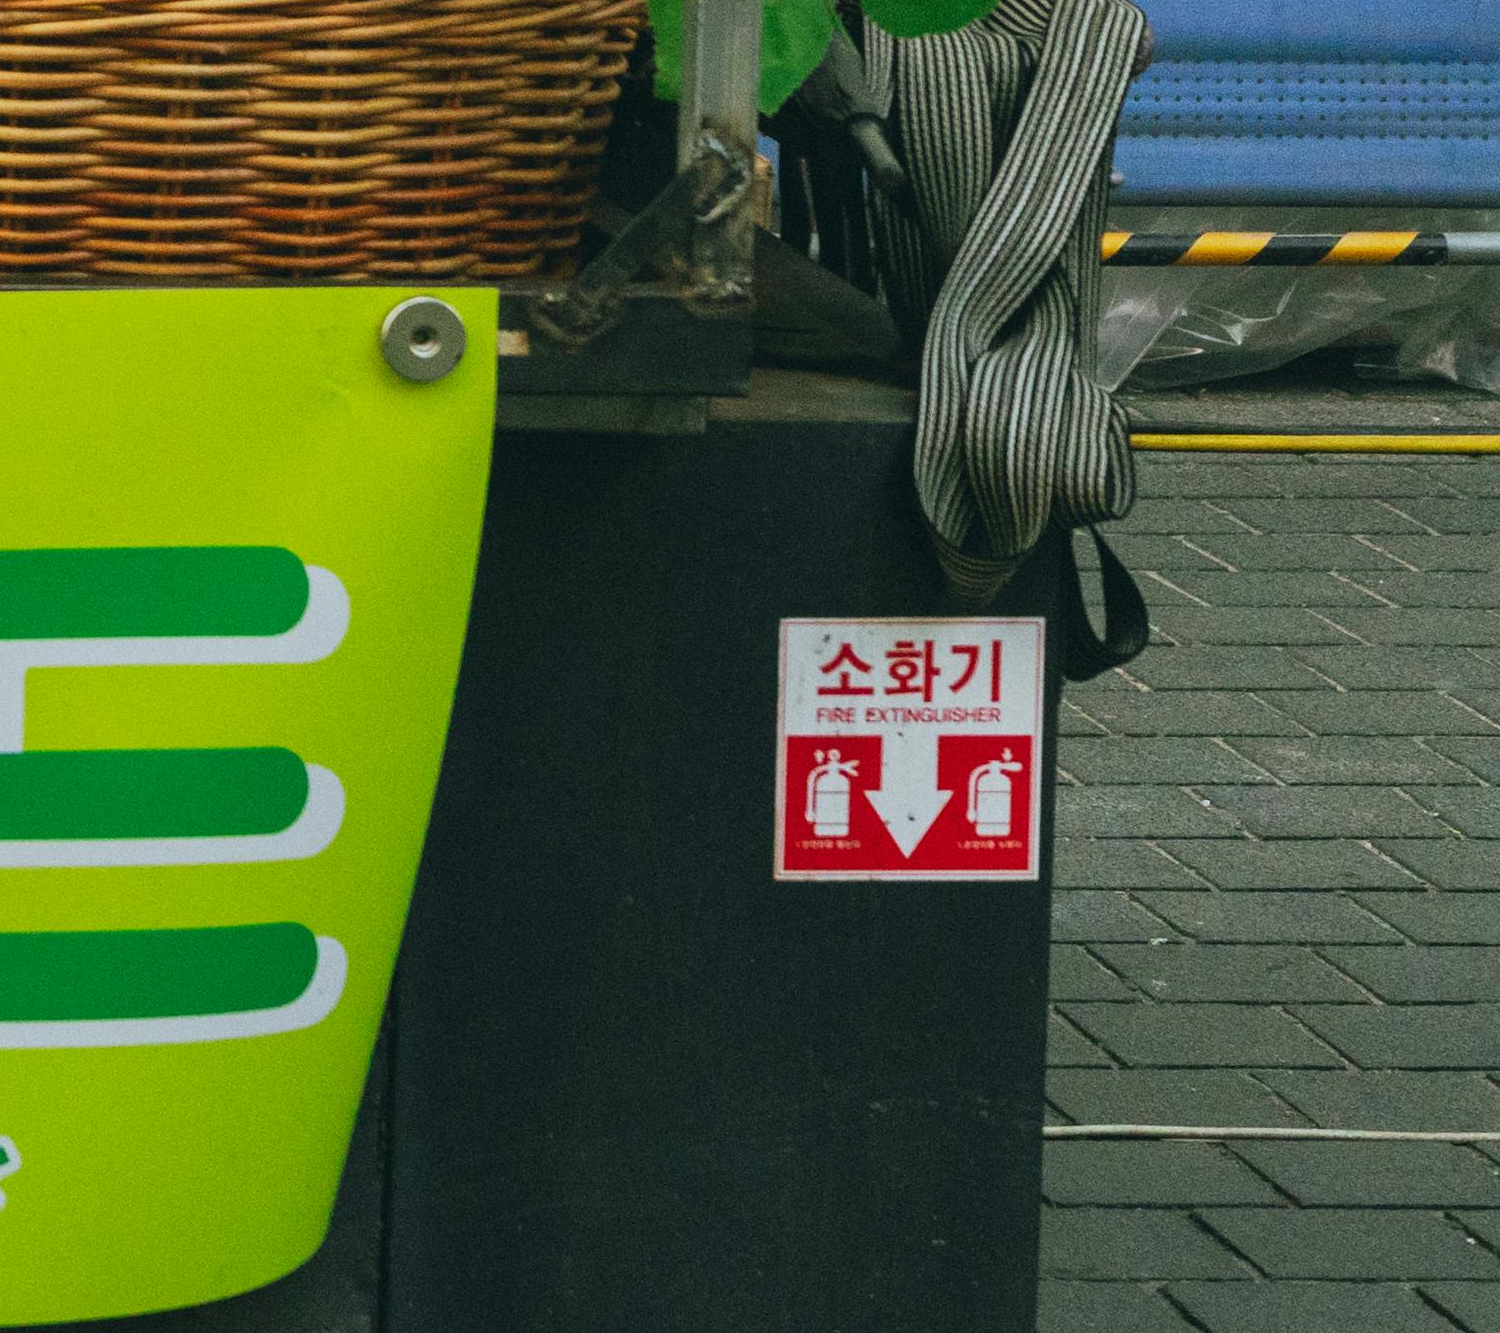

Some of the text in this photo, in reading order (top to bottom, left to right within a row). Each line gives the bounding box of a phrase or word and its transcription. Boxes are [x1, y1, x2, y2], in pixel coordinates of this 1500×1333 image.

[816, 639, 1003, 703] 소화기
[815, 707, 1001, 723] FIRE EXTINGUISHER
